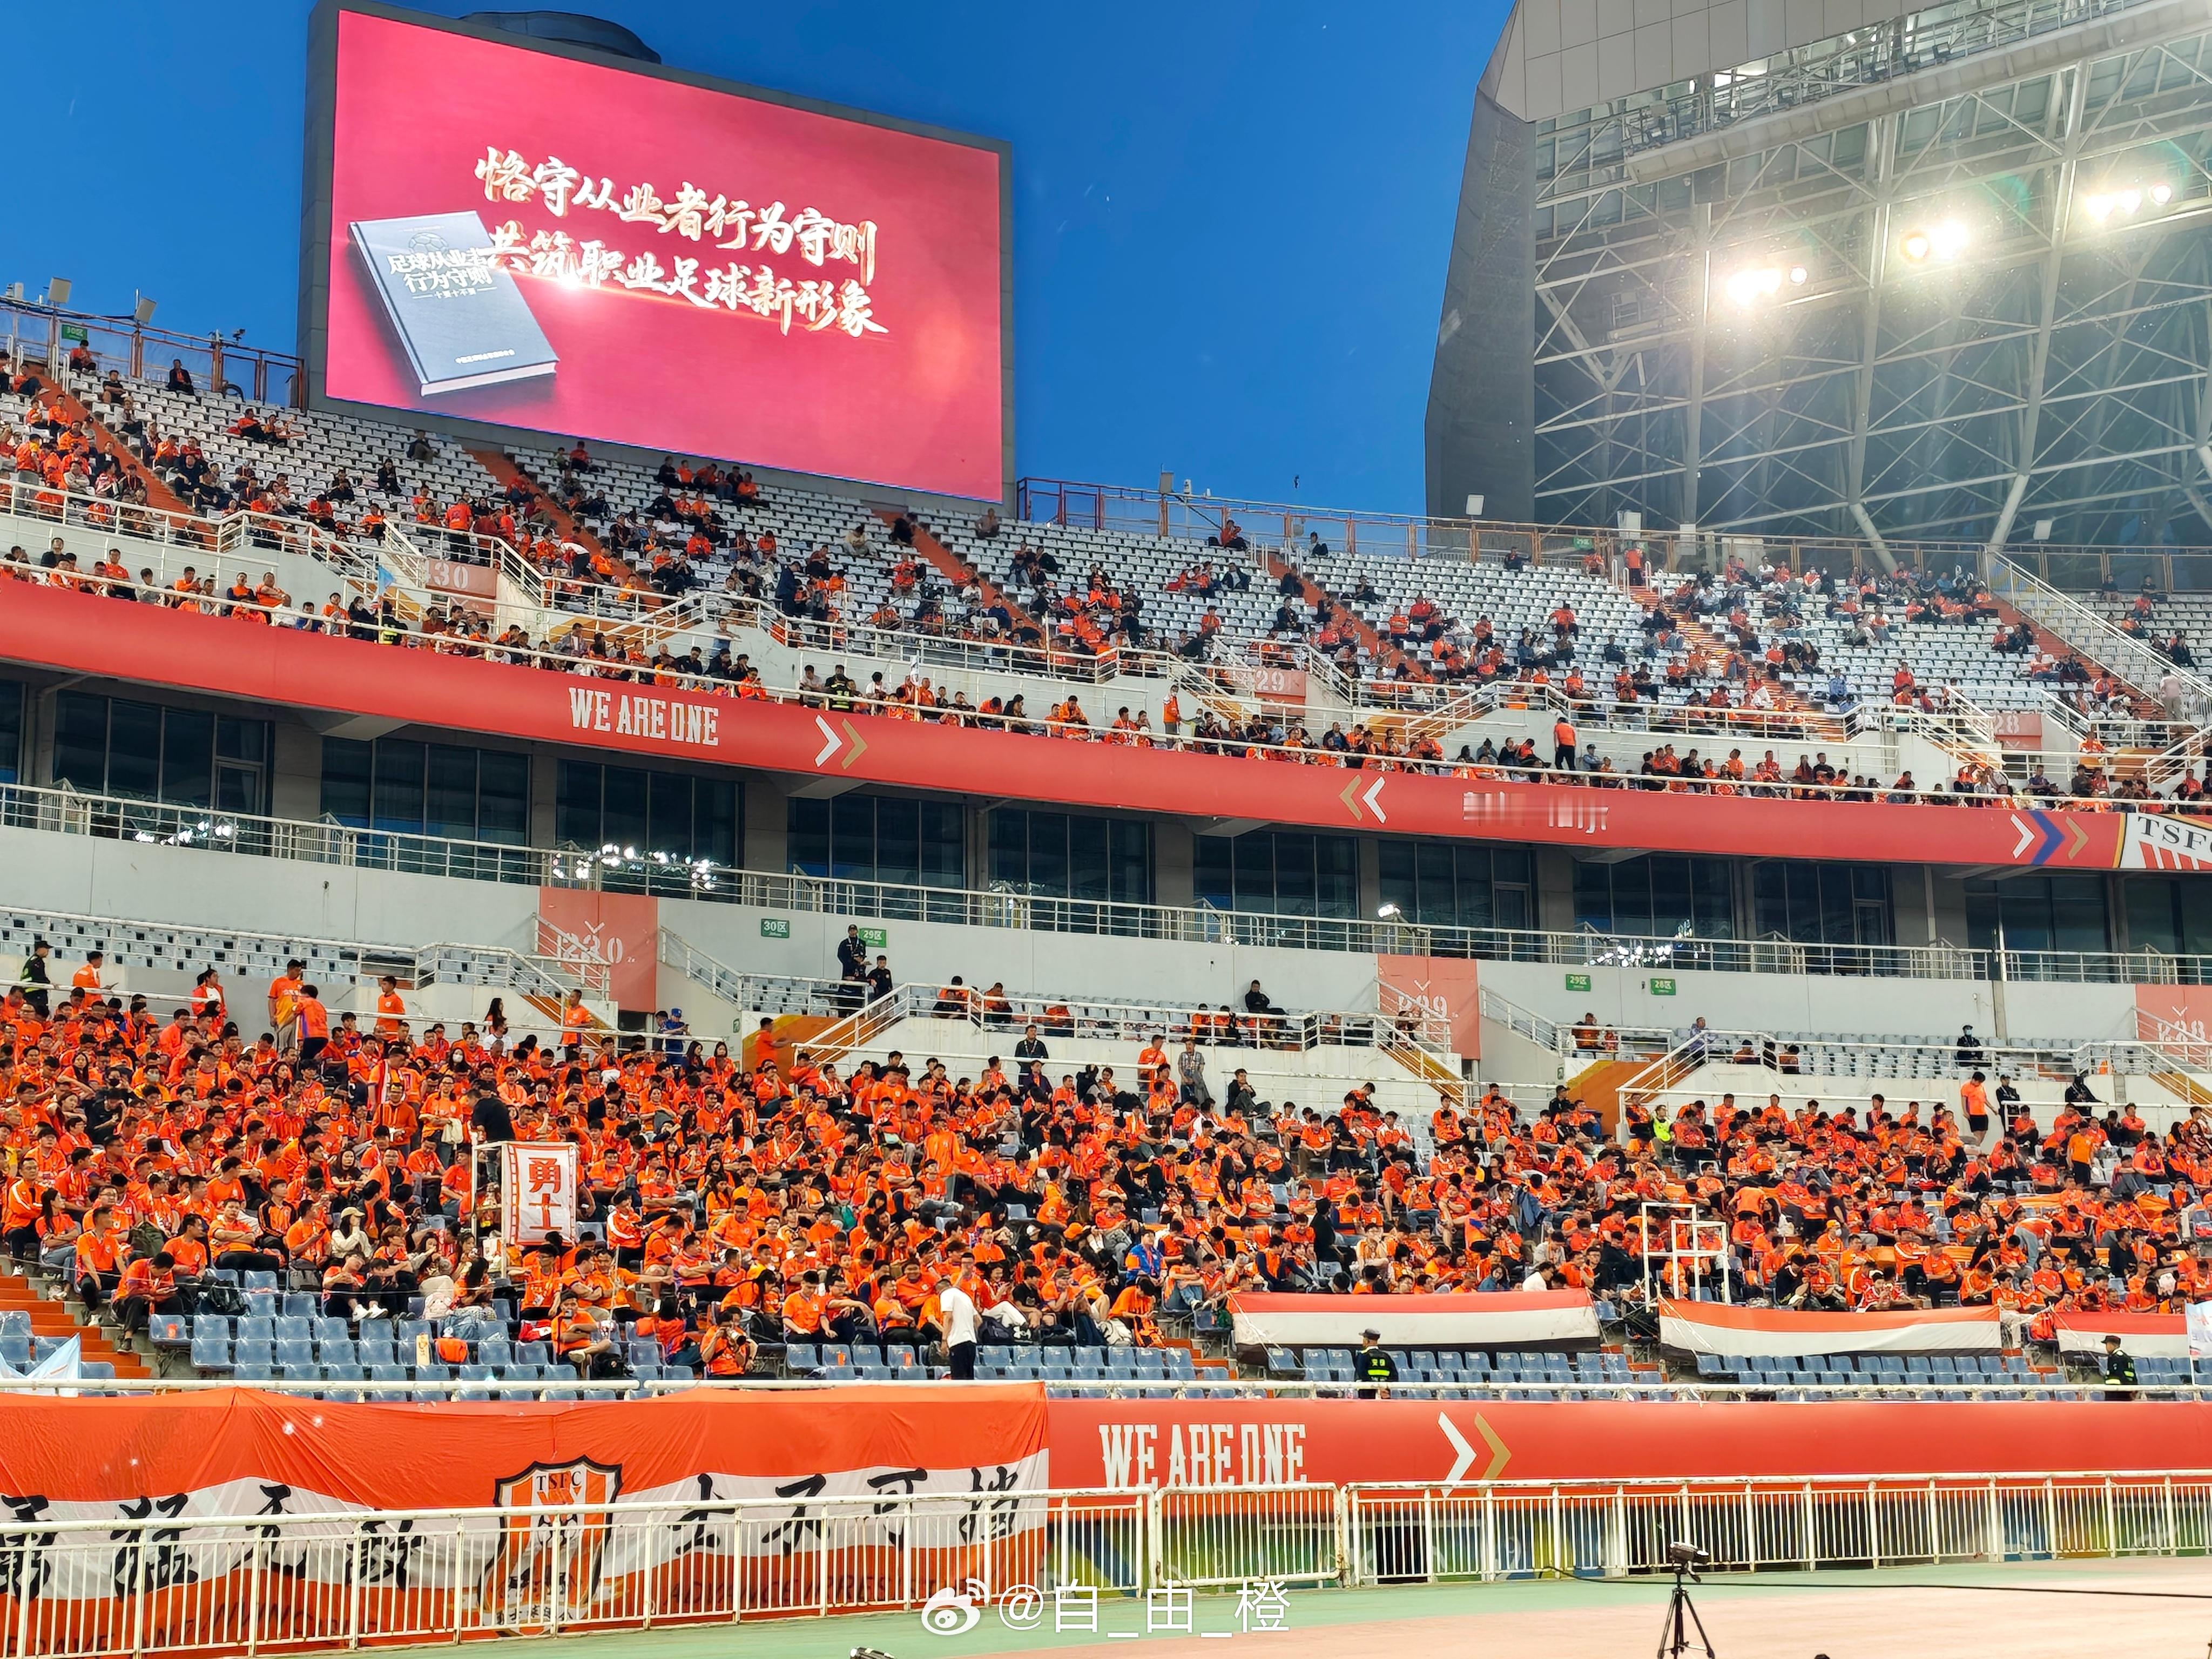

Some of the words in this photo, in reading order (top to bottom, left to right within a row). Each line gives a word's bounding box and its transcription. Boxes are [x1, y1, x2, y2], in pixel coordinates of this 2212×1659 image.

[474, 146, 877, 285] 恪守从业者行为守则
[387, 249, 488, 274] 足球从业者
[403, 266, 493, 293] 行为守则
[478, 220, 888, 337] 共筑职业足球新形象
[568, 687, 611, 732] WE
[616, 694, 667, 739] ARE
[670, 702, 719, 746] ONE
[2137, 816, 2212, 852] TSF
[764, 920, 787, 933] 30区
[863, 930, 882, 940] 29区
[528, 1157, 563, 1230] 勇士
[1098, 1424, 1158, 1489] WE
[1166, 1424, 1236, 1486] ARE
[1240, 1423, 1307, 1485] ONE
[536, 1471, 582, 1491] TSFC
